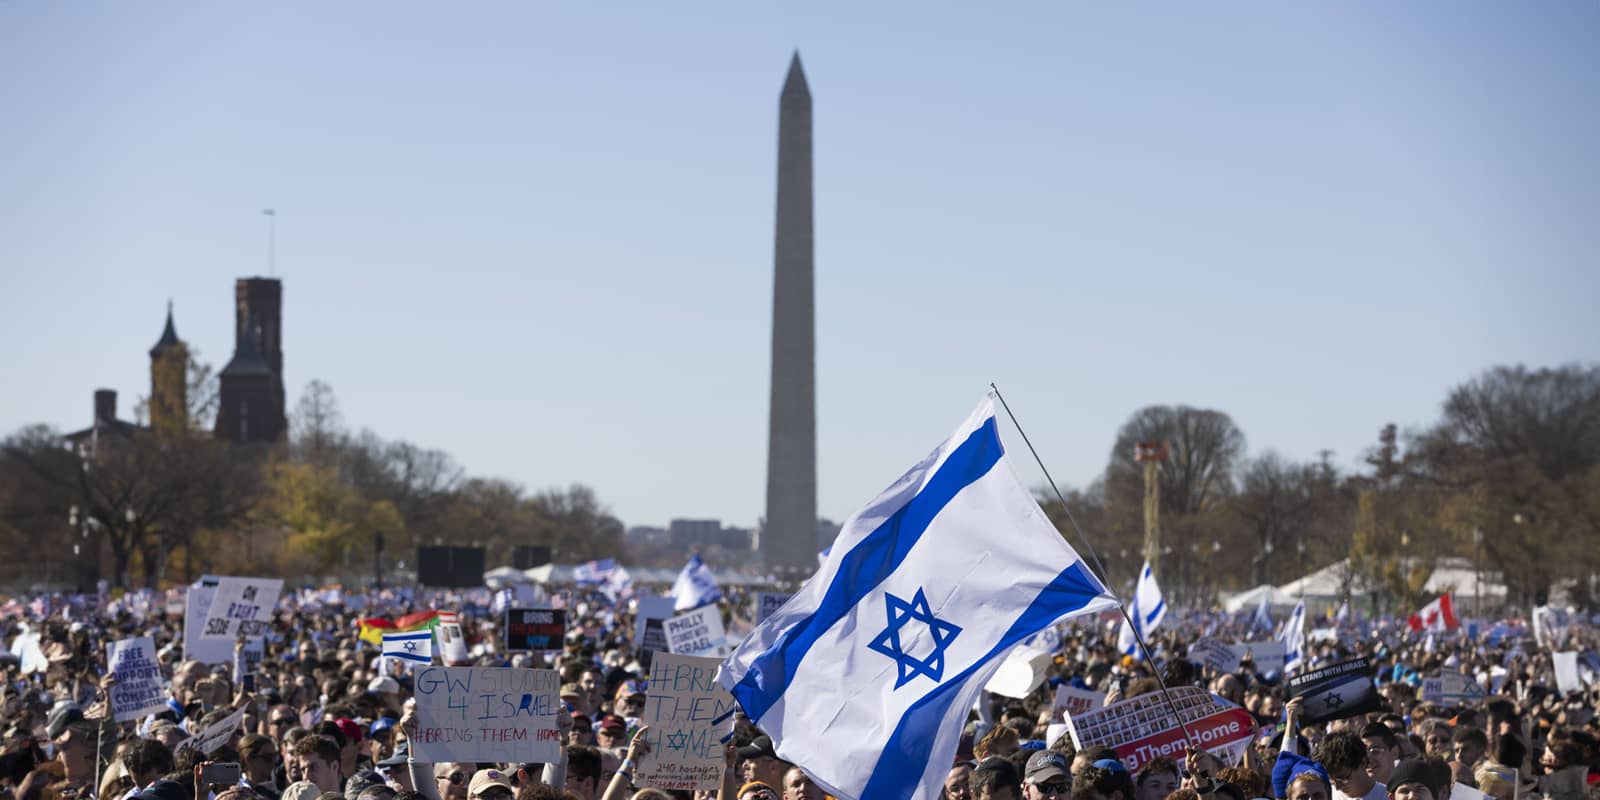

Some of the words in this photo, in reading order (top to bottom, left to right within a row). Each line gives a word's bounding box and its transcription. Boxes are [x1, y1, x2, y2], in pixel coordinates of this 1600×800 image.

[523, 611, 554, 624] BRING
[669, 611, 704, 634] PHILLY
[206, 618, 231, 636] SIDE
[118, 647, 144, 661] FREE
[674, 637, 714, 654] ISRAEL
[417, 667, 473, 695] GW
[650, 661, 725, 693] #BRI
[1290, 677, 1302, 688] WE
[1302, 670, 1324, 684] STAND
[1323, 664, 1342, 677] WITH
[1342, 659, 1367, 673] ISRAEL
[115, 686, 161, 705] COMBAT
[1066, 696, 1093, 709] FREE
[447, 695, 470, 721] 4
[478, 693, 561, 720] ISRAEL
[648, 694, 735, 722] THEM
[414, 727, 473, 744] #BRING
[480, 727, 528, 743] THEM
[536, 727, 560, 742] HOME
[679, 765, 720, 776] hostages
